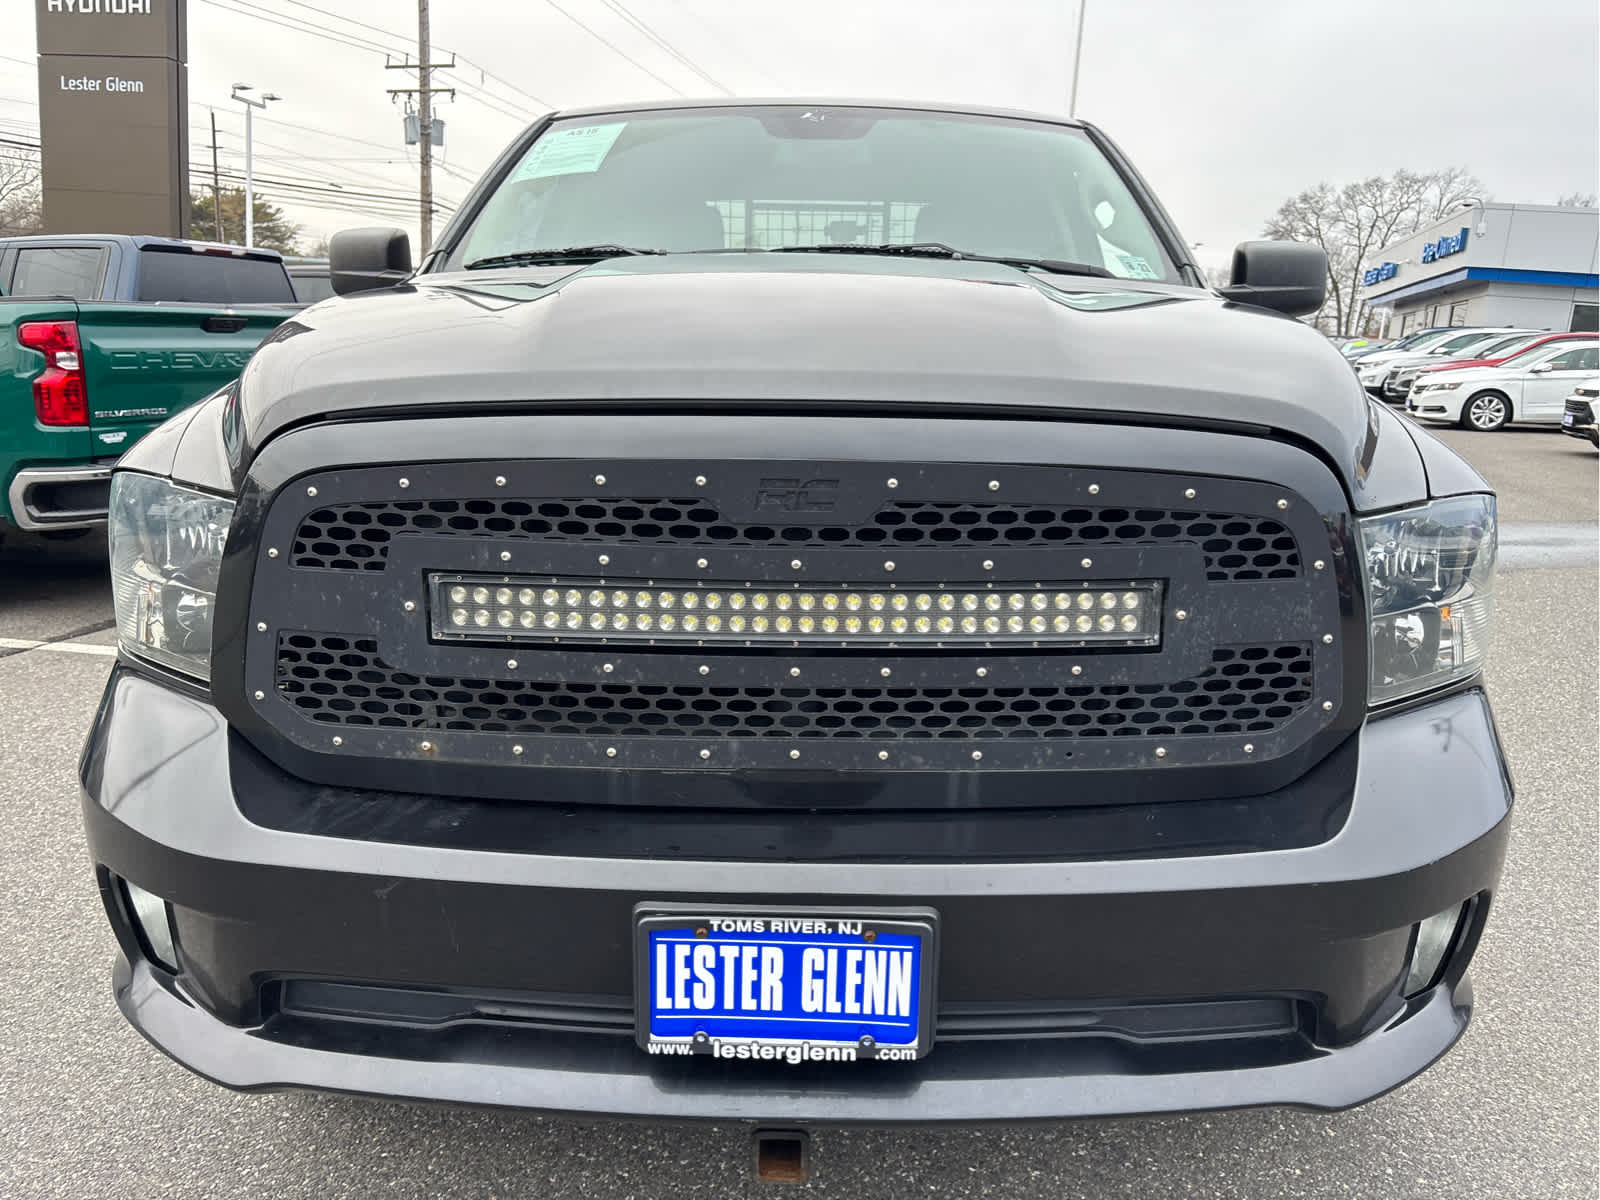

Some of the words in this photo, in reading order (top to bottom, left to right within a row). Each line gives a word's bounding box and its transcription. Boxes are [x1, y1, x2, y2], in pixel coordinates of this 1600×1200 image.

[60, 75, 102, 91] Lester
[105, 76, 144, 92] Glenn
[110, 351, 252, 370] CHEVR
[709, 919, 765, 934] TOMS
[771, 920, 833, 935] RIVER,
[837, 921, 863, 936] NJ
[655, 943, 785, 1012] LESTER
[800, 947, 913, 1017] GLENN
[647, 1042, 694, 1056] www.
[712, 1038, 857, 1065] lesterglenn
[874, 1046, 917, 1061] .com
